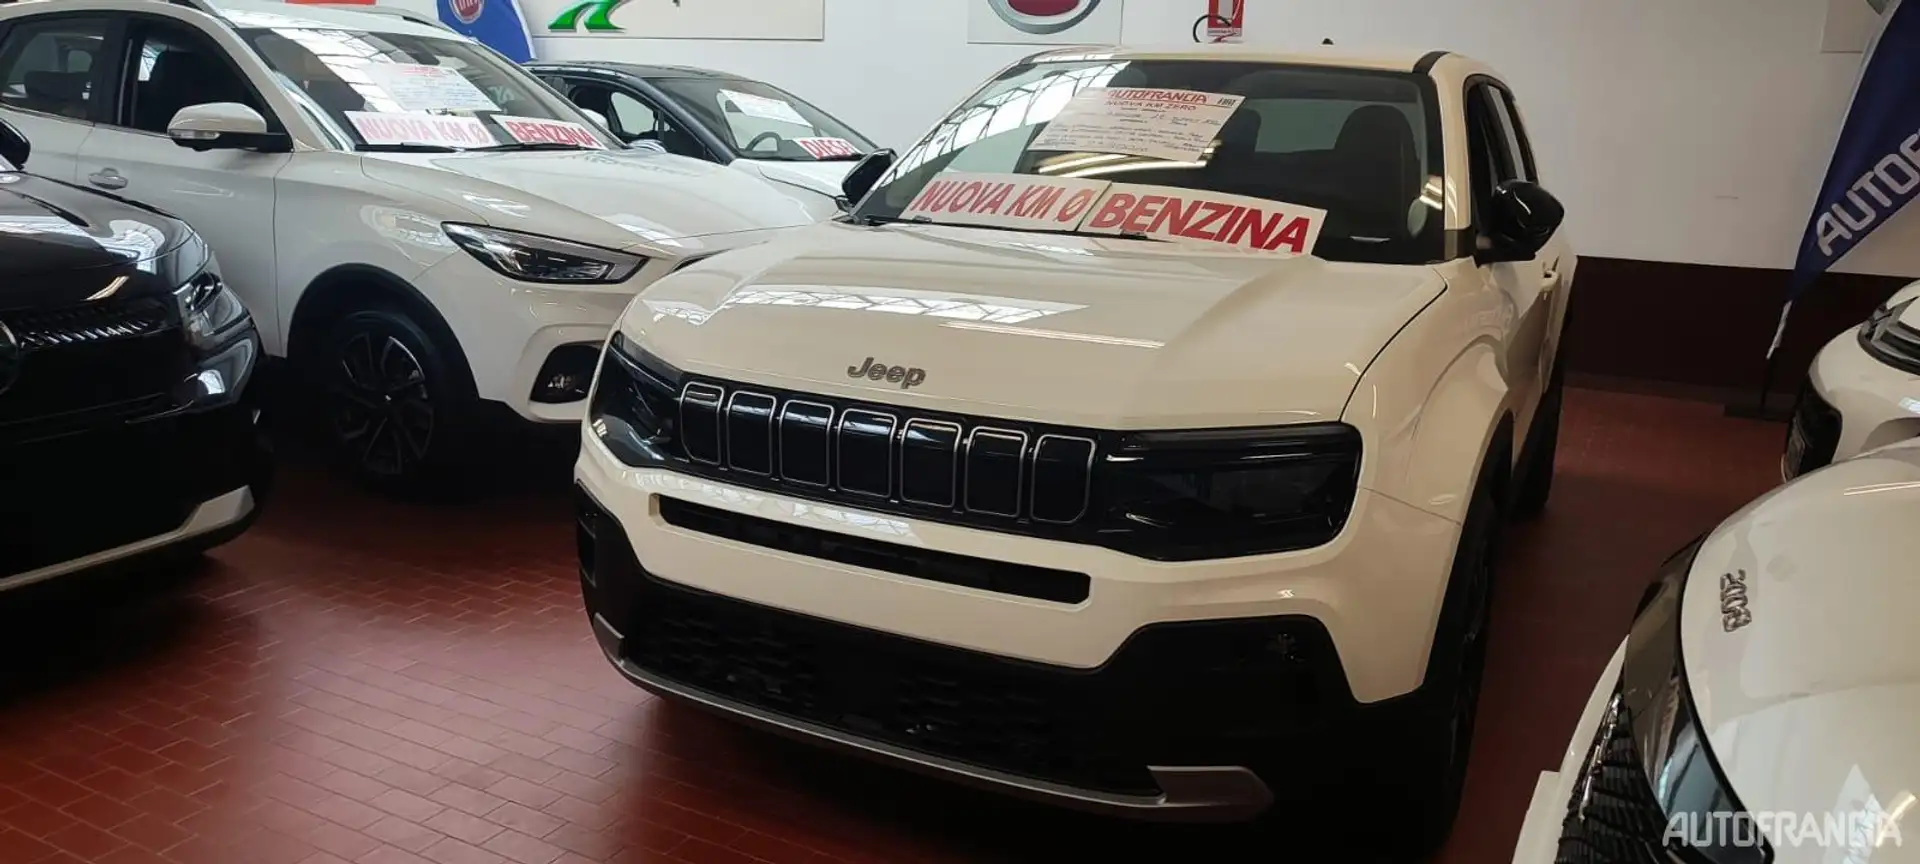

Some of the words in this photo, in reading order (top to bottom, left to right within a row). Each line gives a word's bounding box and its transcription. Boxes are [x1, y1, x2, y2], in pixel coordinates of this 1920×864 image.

[1109, 90, 1207, 103] AUTOFRANCIA
[1164, 103, 1197, 111] ZERO
[356, 118, 437, 140] NUOVA
[432, 119, 472, 143] KM
[505, 121, 602, 147] BENZINA
[910, 180, 1015, 215] NUOVA
[1003, 184, 1066, 220] KM
[1089, 193, 1310, 253] BENZINA
[847, 356, 926, 389] Jeep
[1720, 569, 1752, 632] 2008
